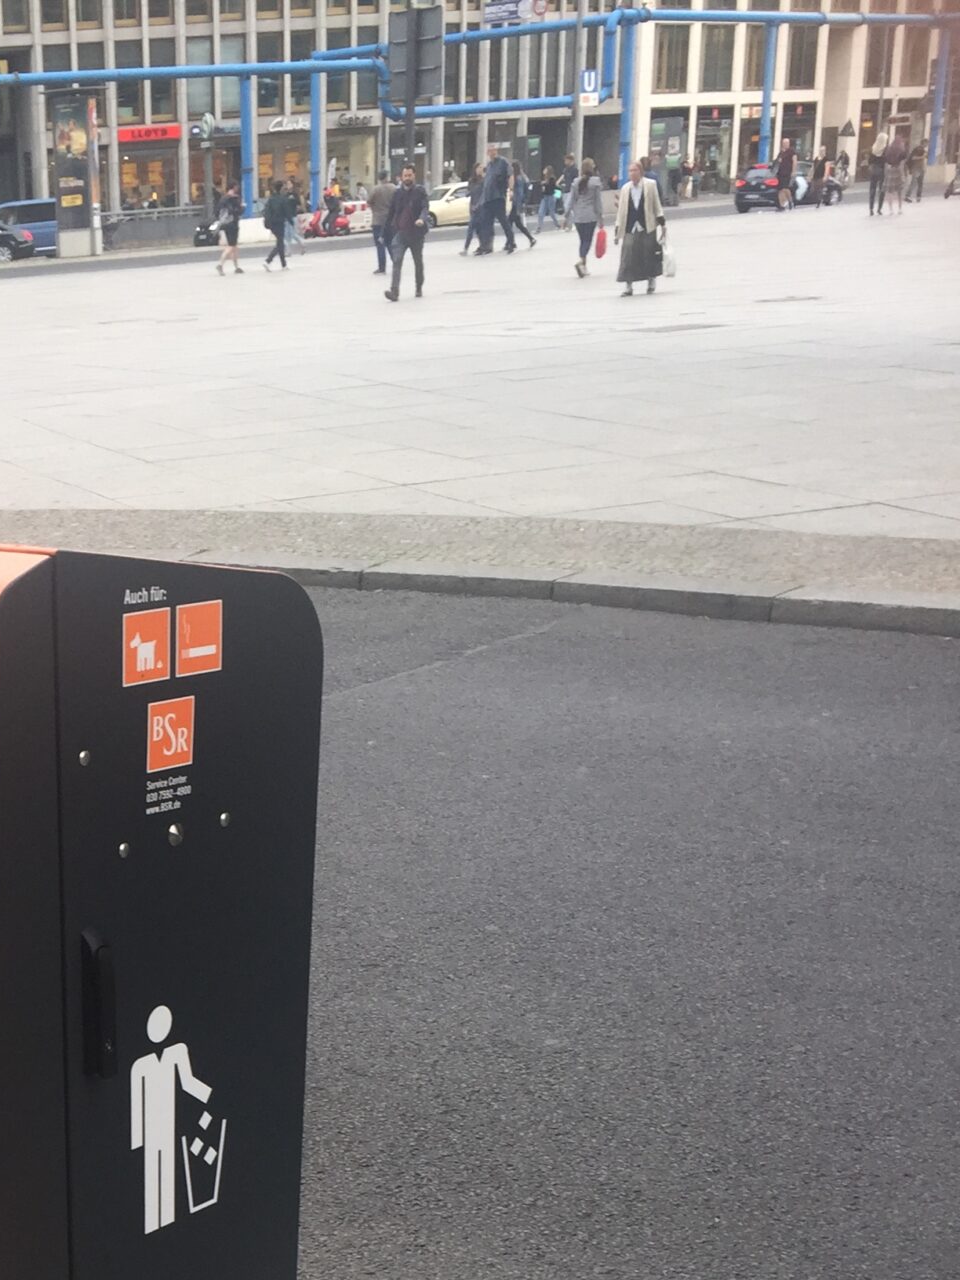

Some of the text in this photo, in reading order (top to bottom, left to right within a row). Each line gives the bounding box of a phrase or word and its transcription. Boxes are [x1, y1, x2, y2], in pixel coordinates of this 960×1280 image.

[583, 71, 596, 92] U
[131, 127, 169, 139] LLOYD
[123, 585, 167, 605] Auch für:
[152, 713, 189, 756] BSR
[146, 776, 188, 790] Service Center
